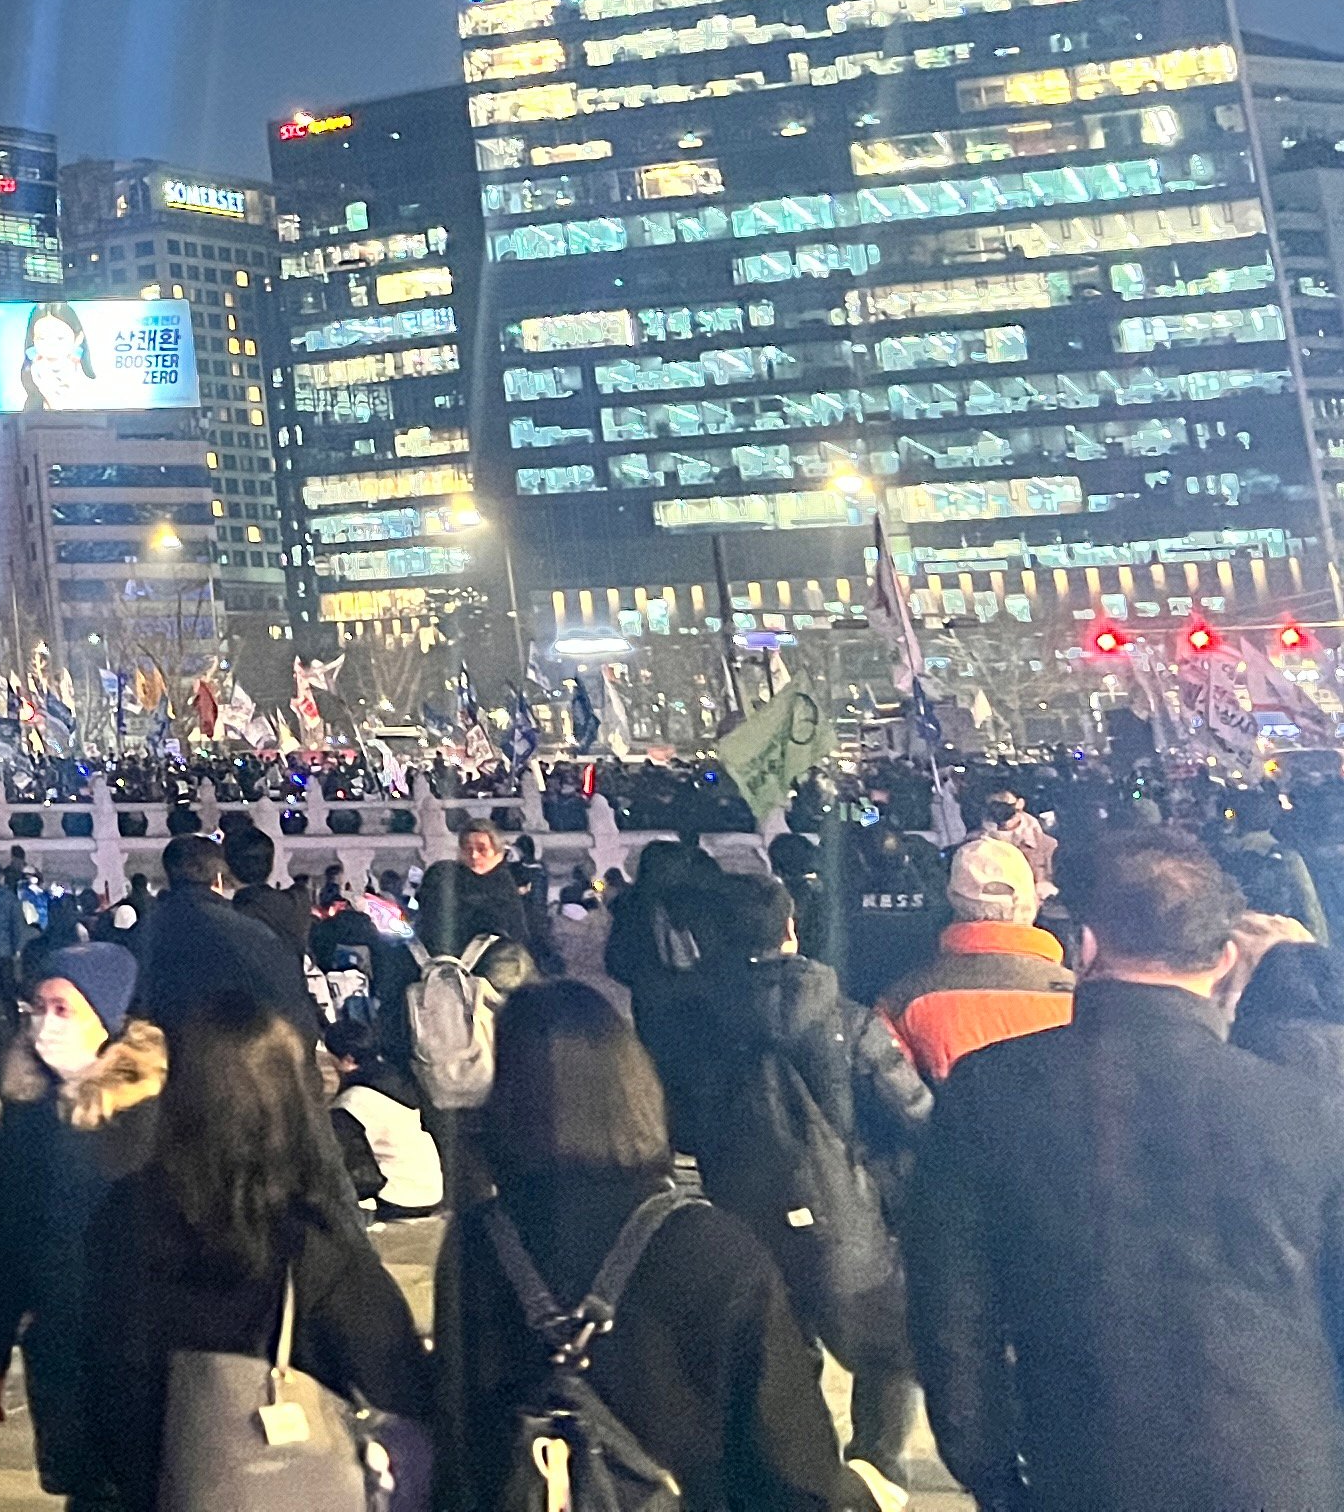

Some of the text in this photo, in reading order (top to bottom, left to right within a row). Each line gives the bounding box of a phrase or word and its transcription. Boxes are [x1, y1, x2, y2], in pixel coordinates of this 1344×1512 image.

[163, 180, 245, 213] SOMERSET
[114, 328, 182, 352] 상쾌환
[115, 354, 179, 369] BOOSTER
[142, 370, 178, 384] ZERO
